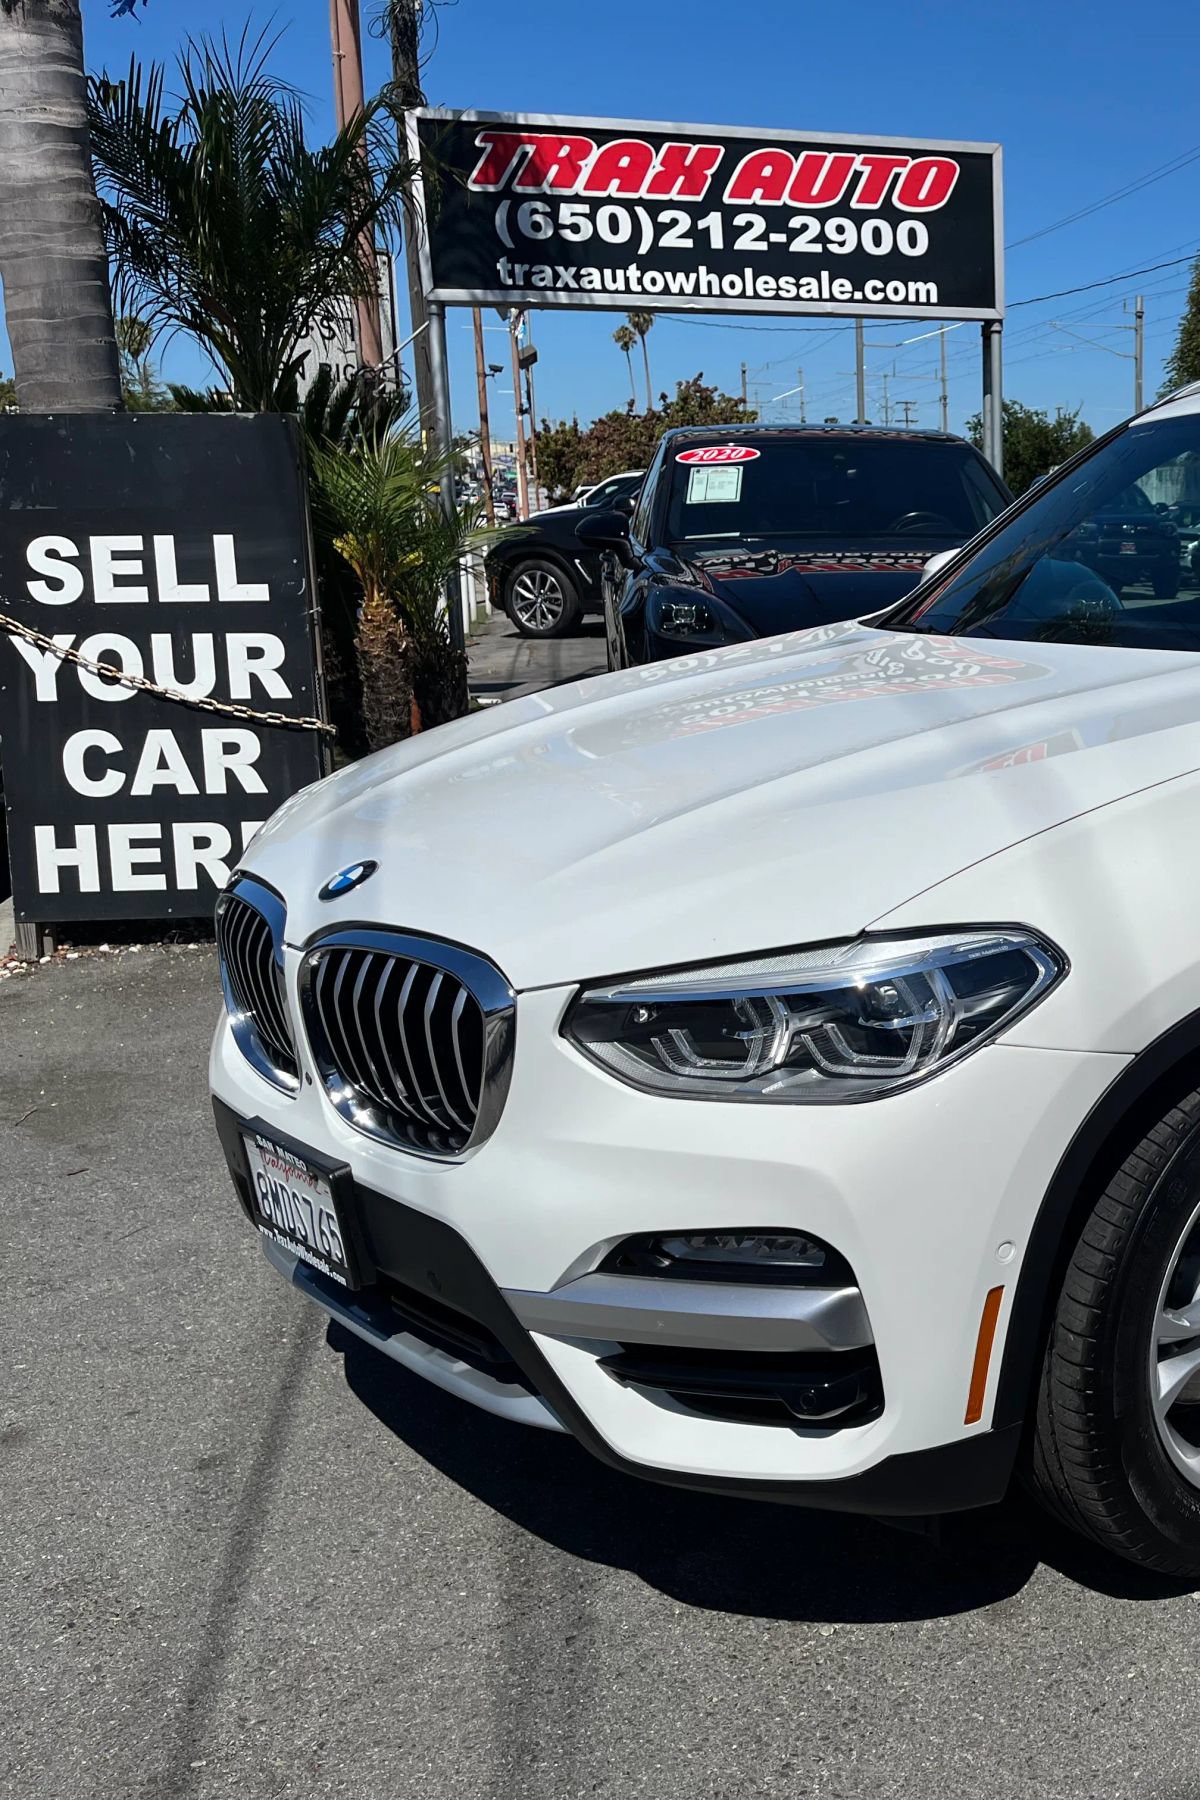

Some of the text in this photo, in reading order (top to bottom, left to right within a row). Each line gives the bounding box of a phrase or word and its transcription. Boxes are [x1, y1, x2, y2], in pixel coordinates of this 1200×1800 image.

[467, 131, 960, 212] TRAX AUTO
[494, 200, 930, 257] (650)212-2900
[496, 255, 938, 304] traxautowholesale.com
[687, 448, 747, 462] 2020
[26, 533, 270, 605] SELL
[8, 631, 293, 703] YOUR
[62, 728, 268, 798] CAR
[34, 821, 266, 894] HER
[257, 1171, 347, 1266] 8MDS765
